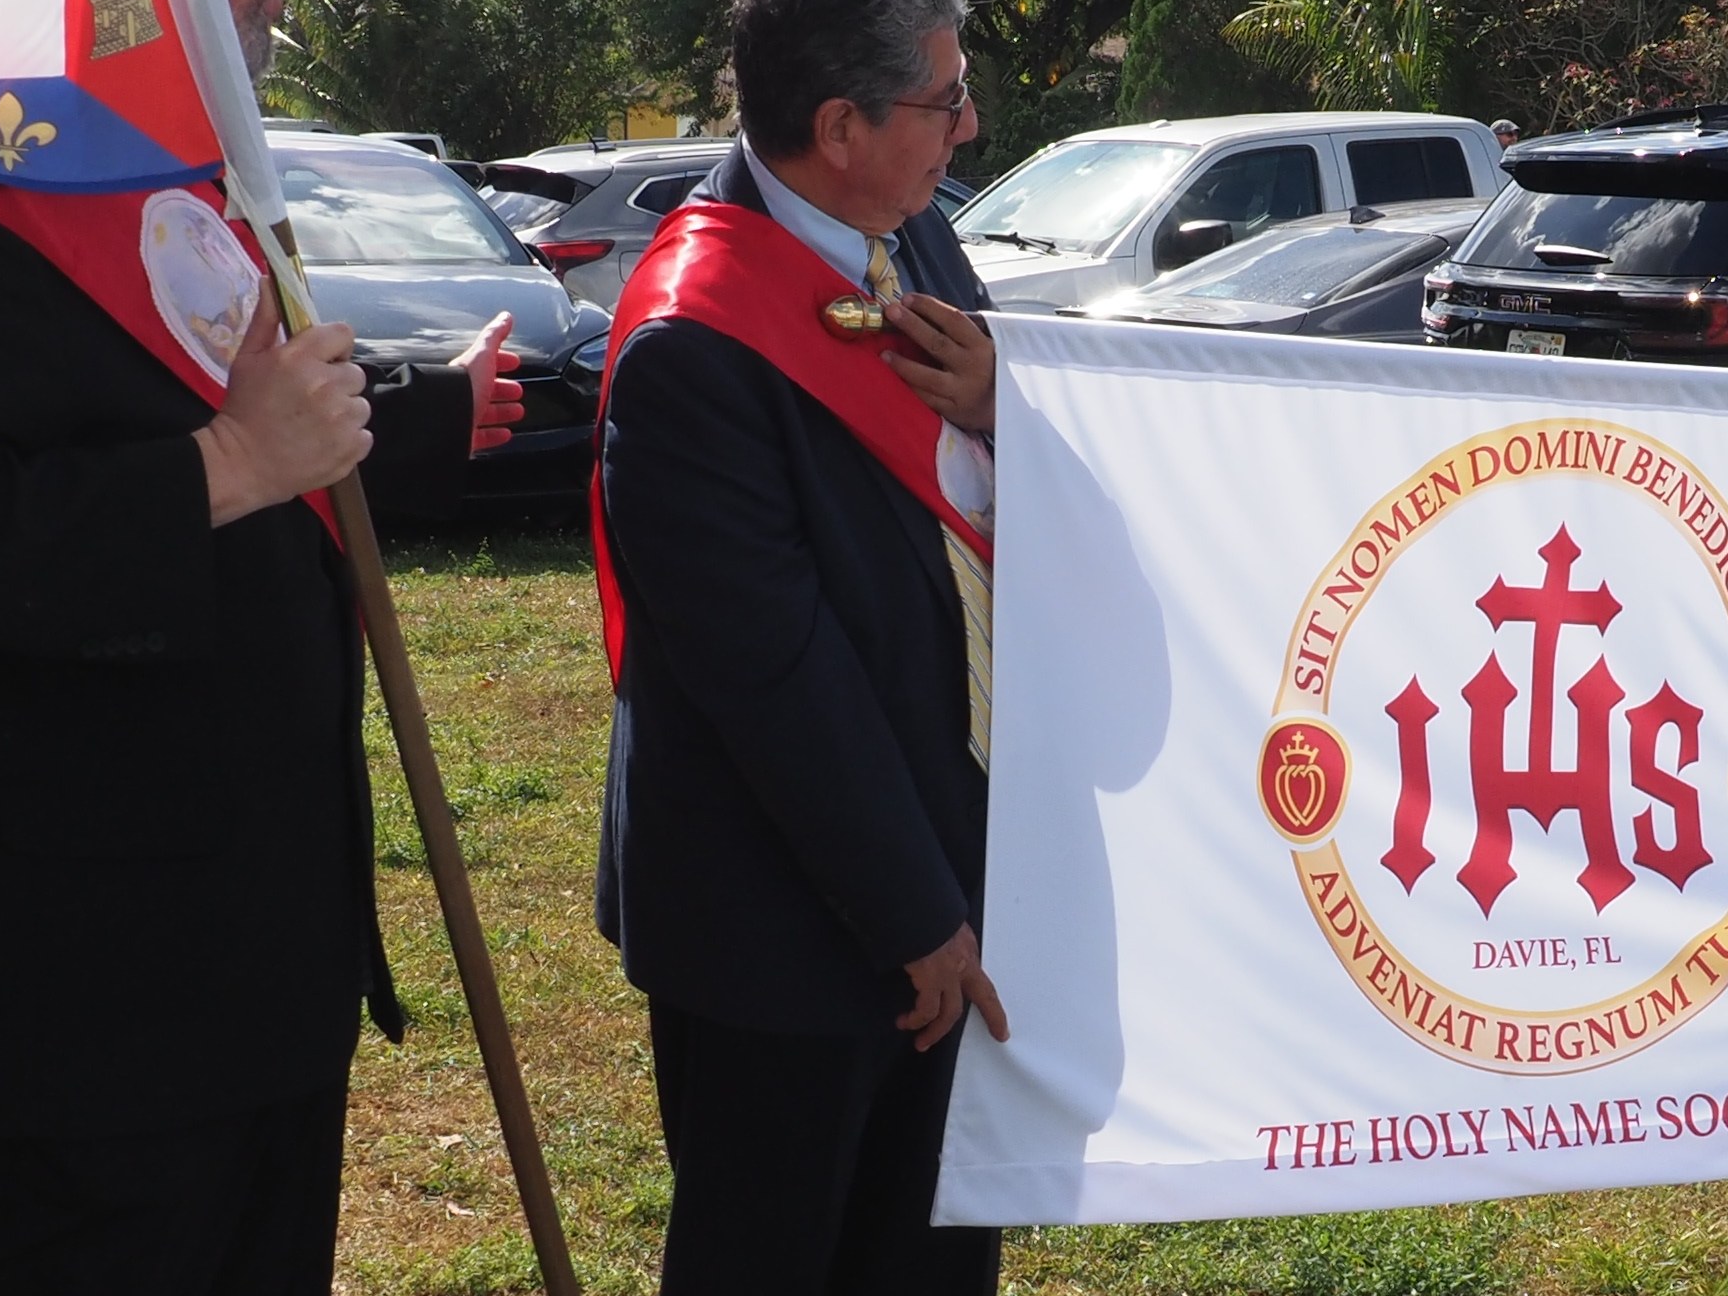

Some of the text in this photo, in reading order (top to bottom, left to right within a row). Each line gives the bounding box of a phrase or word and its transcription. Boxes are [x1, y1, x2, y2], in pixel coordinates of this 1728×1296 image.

[1499, 293, 1552, 314] GMC
[1294, 610, 1338, 695] SIT
[1322, 460, 1461, 614] NOMEN
[1466, 429, 1627, 488] DOMINI
[1309, 872, 1487, 1052] ADVENIAT
[1494, 974, 1693, 1063] REGNUM
[1473, 935, 1622, 971] DAVIE, FL
[1256, 1119, 1357, 1171] THE
[1368, 1109, 1490, 1164] HOLY
[1506, 1098, 1647, 1152] NAME
